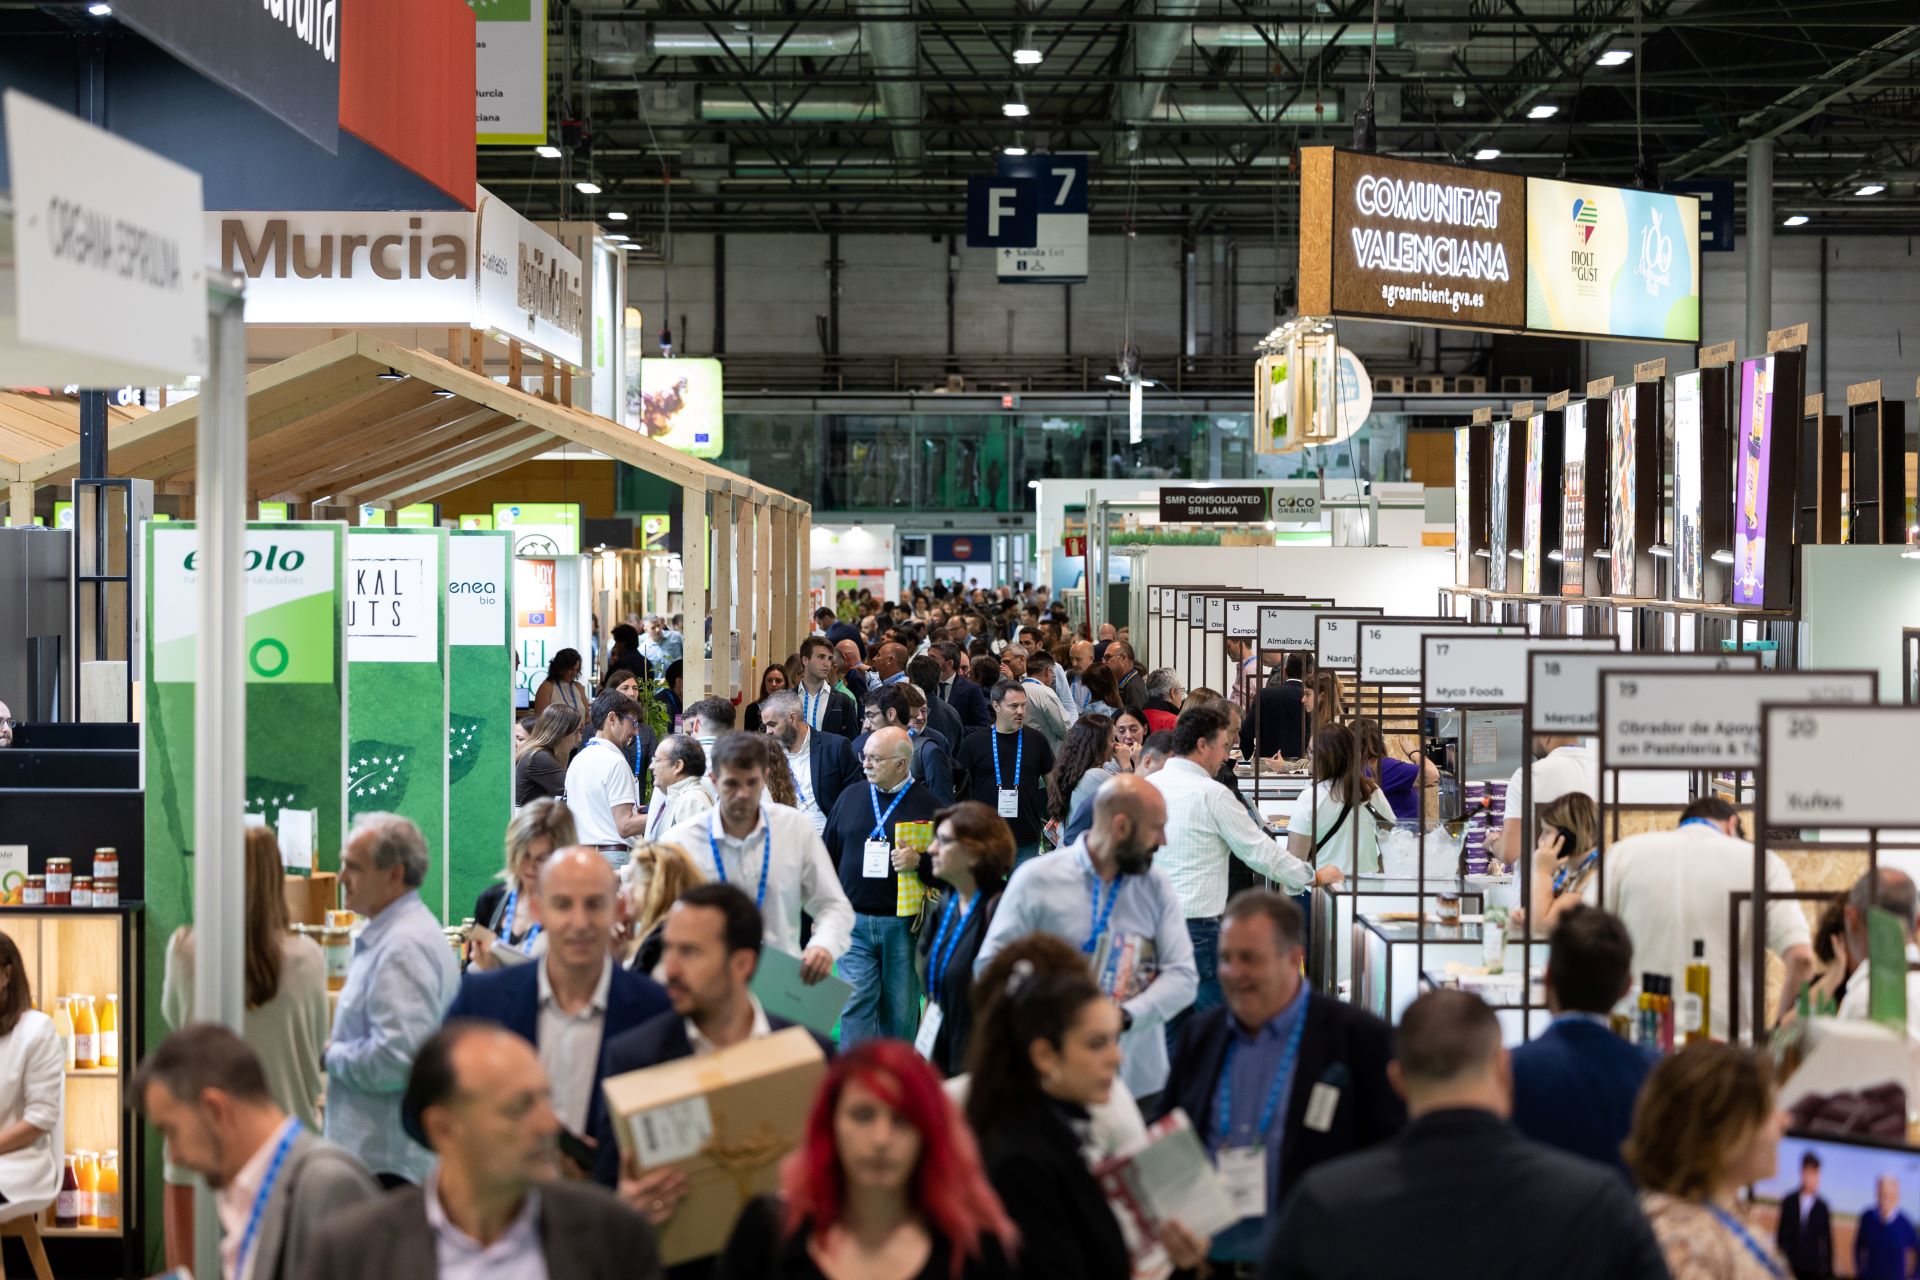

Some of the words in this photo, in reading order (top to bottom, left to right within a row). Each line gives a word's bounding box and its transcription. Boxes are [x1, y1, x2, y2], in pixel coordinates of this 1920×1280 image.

[1051, 168, 1076, 206] 7
[1356, 174, 1501, 229] COMUNITAT
[988, 188, 1016, 236] F
[221, 218, 467, 280] Murcia
[1016, 249, 1045, 257] Salida
[1352, 227, 1509, 281] VALENCIANA
[1571, 250, 1594, 267] MOLT
[1577, 266, 1599, 282] GUST
[1382, 281, 1485, 312] agroambient.gva.es
[1165, 495, 1186, 505] SMR
[1187, 495, 1261, 505] CONSOLIDATED
[1277, 497, 1315, 508] COCO
[1188, 506, 1204, 515] SRI
[1206, 506, 1239, 515] LANKA
[183, 545, 305, 571] eolo
[479, 596, 496, 605] bio
[1327, 622, 1337, 631] 15
[1267, 637, 1302, 645] Almalibre
[1369, 630, 1382, 640] 16
[1436, 643, 1449, 655] 17
[1544, 661, 1561, 677] 18
[1436, 686, 1467, 699] Myco
[1469, 686, 1504, 697] Foods
[1619, 681, 1638, 698] 19
[1617, 720, 1684, 735] Obrador
[1689, 720, 1708, 735] de
[1787, 717, 1819, 739] 20
